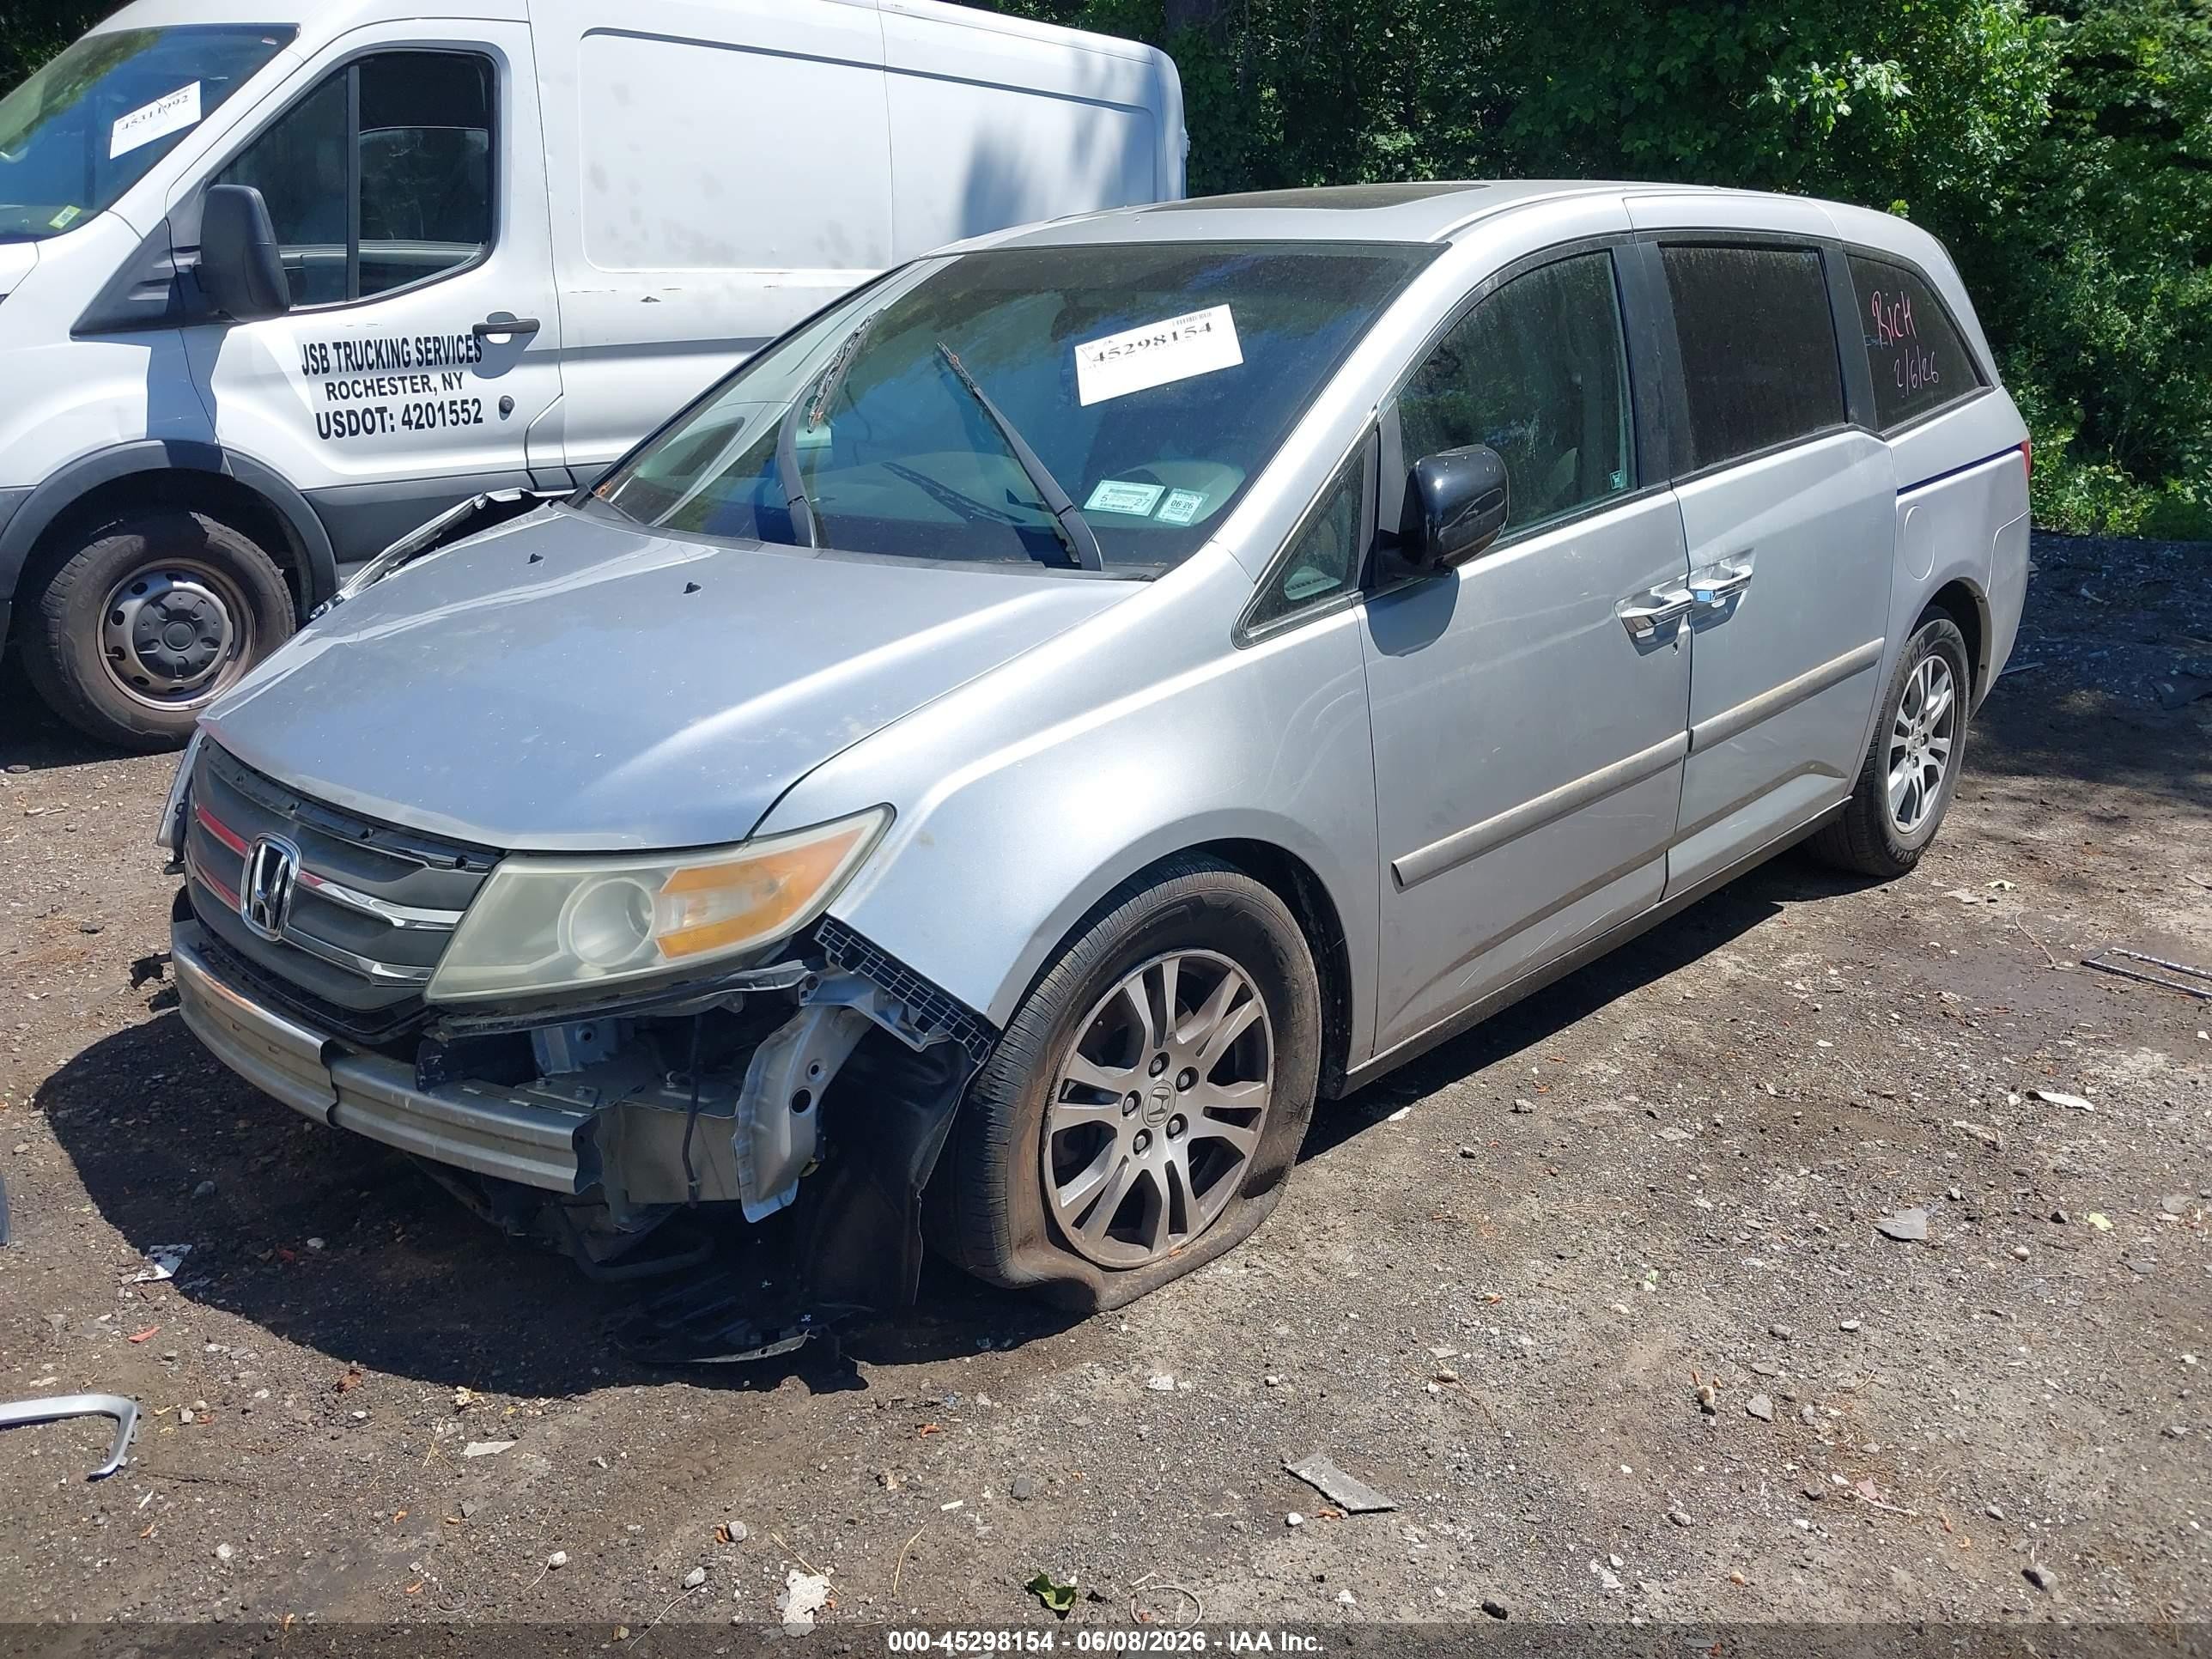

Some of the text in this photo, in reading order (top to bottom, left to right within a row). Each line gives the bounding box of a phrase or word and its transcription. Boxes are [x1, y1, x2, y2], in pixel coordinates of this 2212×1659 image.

[301, 334, 482, 375] JSB TRUCKING SERVICES
[1092, 322, 1212, 362] 45298154
[325, 372, 464, 401] ROCHESTER, NY
[1893, 345, 1939, 396] 2/6/26
[315, 398, 483, 440] USDOT: 4201552
[1133, 498, 1151, 507] 27
